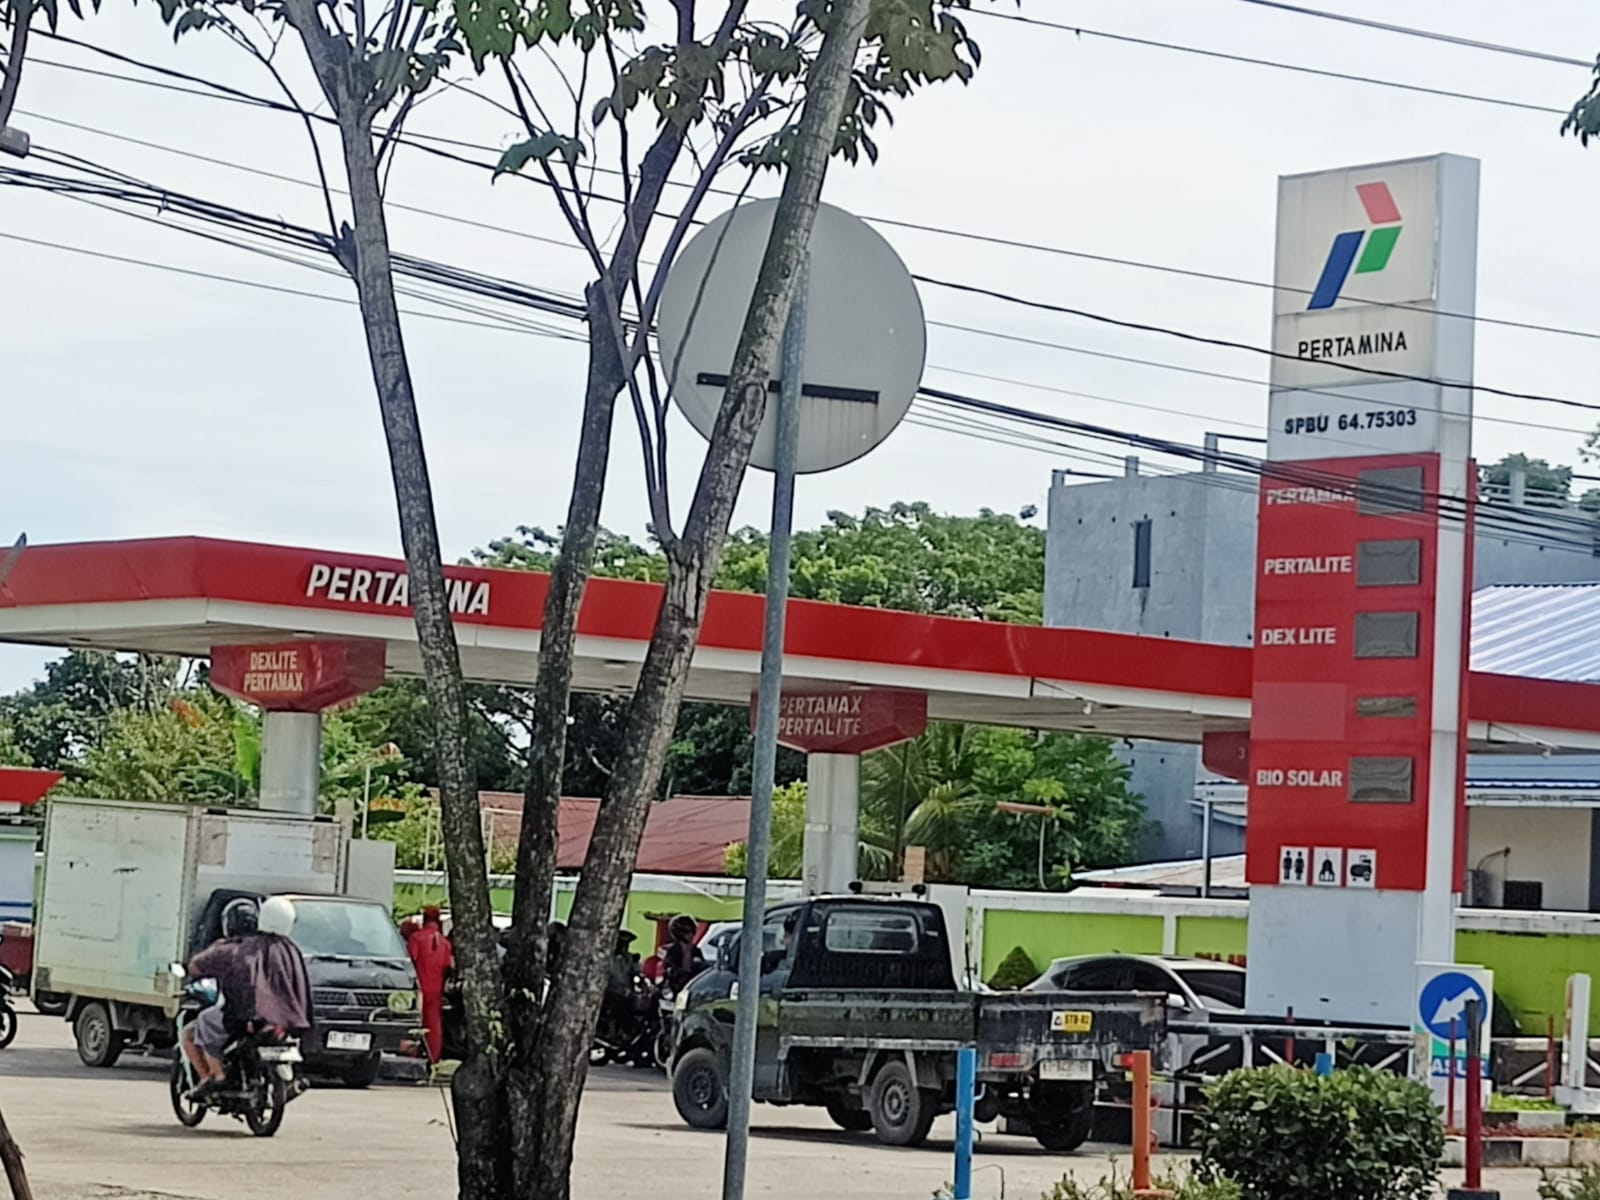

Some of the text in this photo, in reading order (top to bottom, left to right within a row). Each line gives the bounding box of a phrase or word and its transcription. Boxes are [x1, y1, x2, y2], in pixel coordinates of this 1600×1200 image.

[1298, 331, 1407, 359] PERTAMINA
[1285, 409, 1416, 434] SPBU 64.75303
[1264, 556, 1352, 575] PERTALITE
[306, 563, 490, 616] PERTANA
[1261, 628, 1337, 646] DEX LITE
[250, 651, 298, 671] DEXLITE
[243, 672, 304, 692] PERTAMAX
[779, 717, 862, 736] PERTALITE
[1256, 769, 1343, 787] BIO SOLAR
